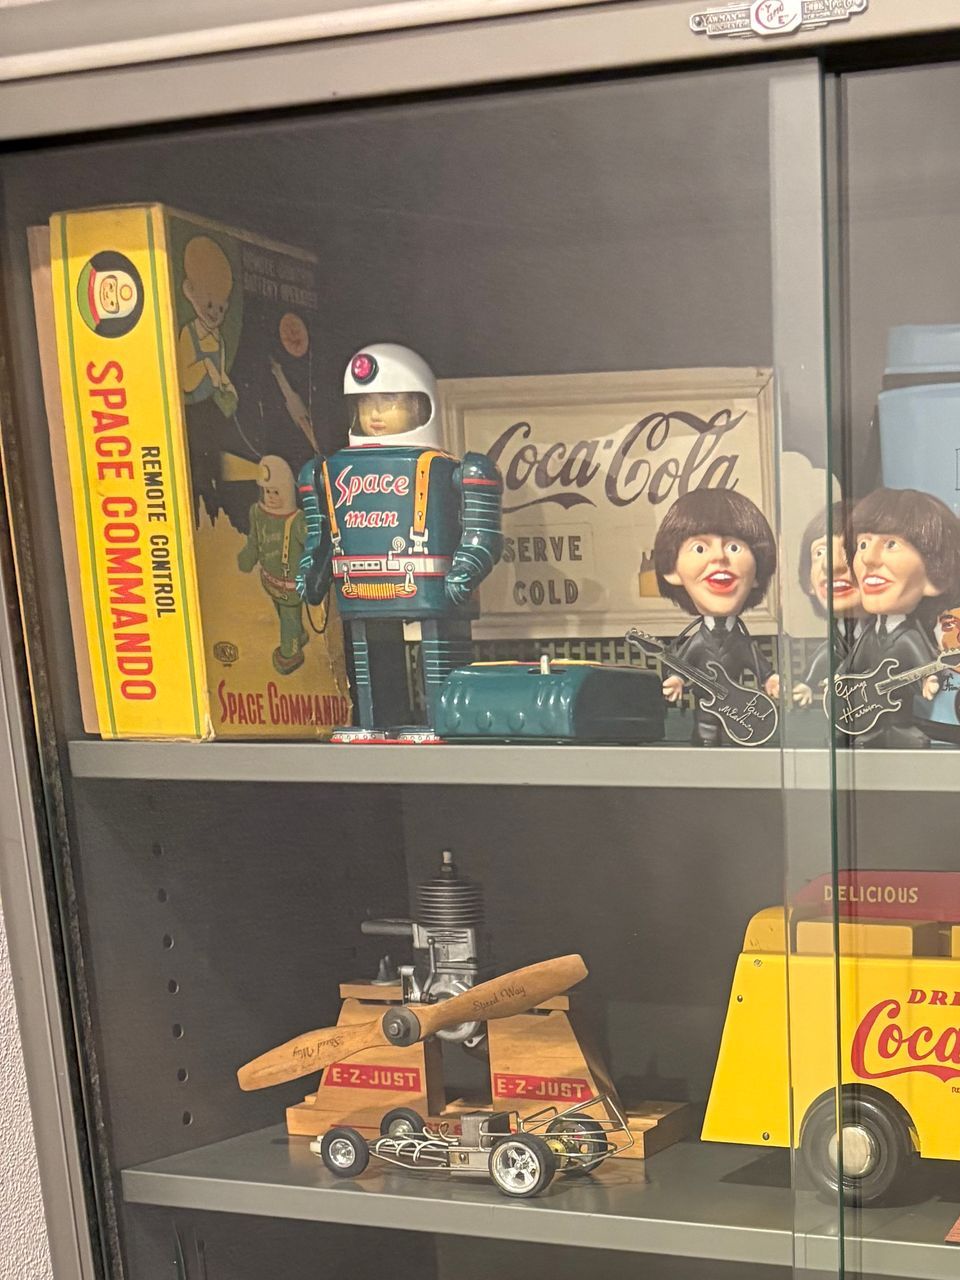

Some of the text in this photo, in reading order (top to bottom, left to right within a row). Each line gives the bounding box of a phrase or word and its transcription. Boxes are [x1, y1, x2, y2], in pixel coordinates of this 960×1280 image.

[484, 408, 748, 515] Coca-Cola
[334, 465, 409, 509] Space
[86, 361, 157, 701] SPACE COMMANDO
[141, 446, 176, 618] REMOTE CONTROL
[344, 510, 399, 528] man
[503, 536, 583, 563] SERVE
[513, 579, 579, 606] COLD
[823, 885, 919, 904] DELICIOUS
[332, 1068, 417, 1088] E-Z-JUST
[497, 1078, 585, 1098] E-Z-JUST
